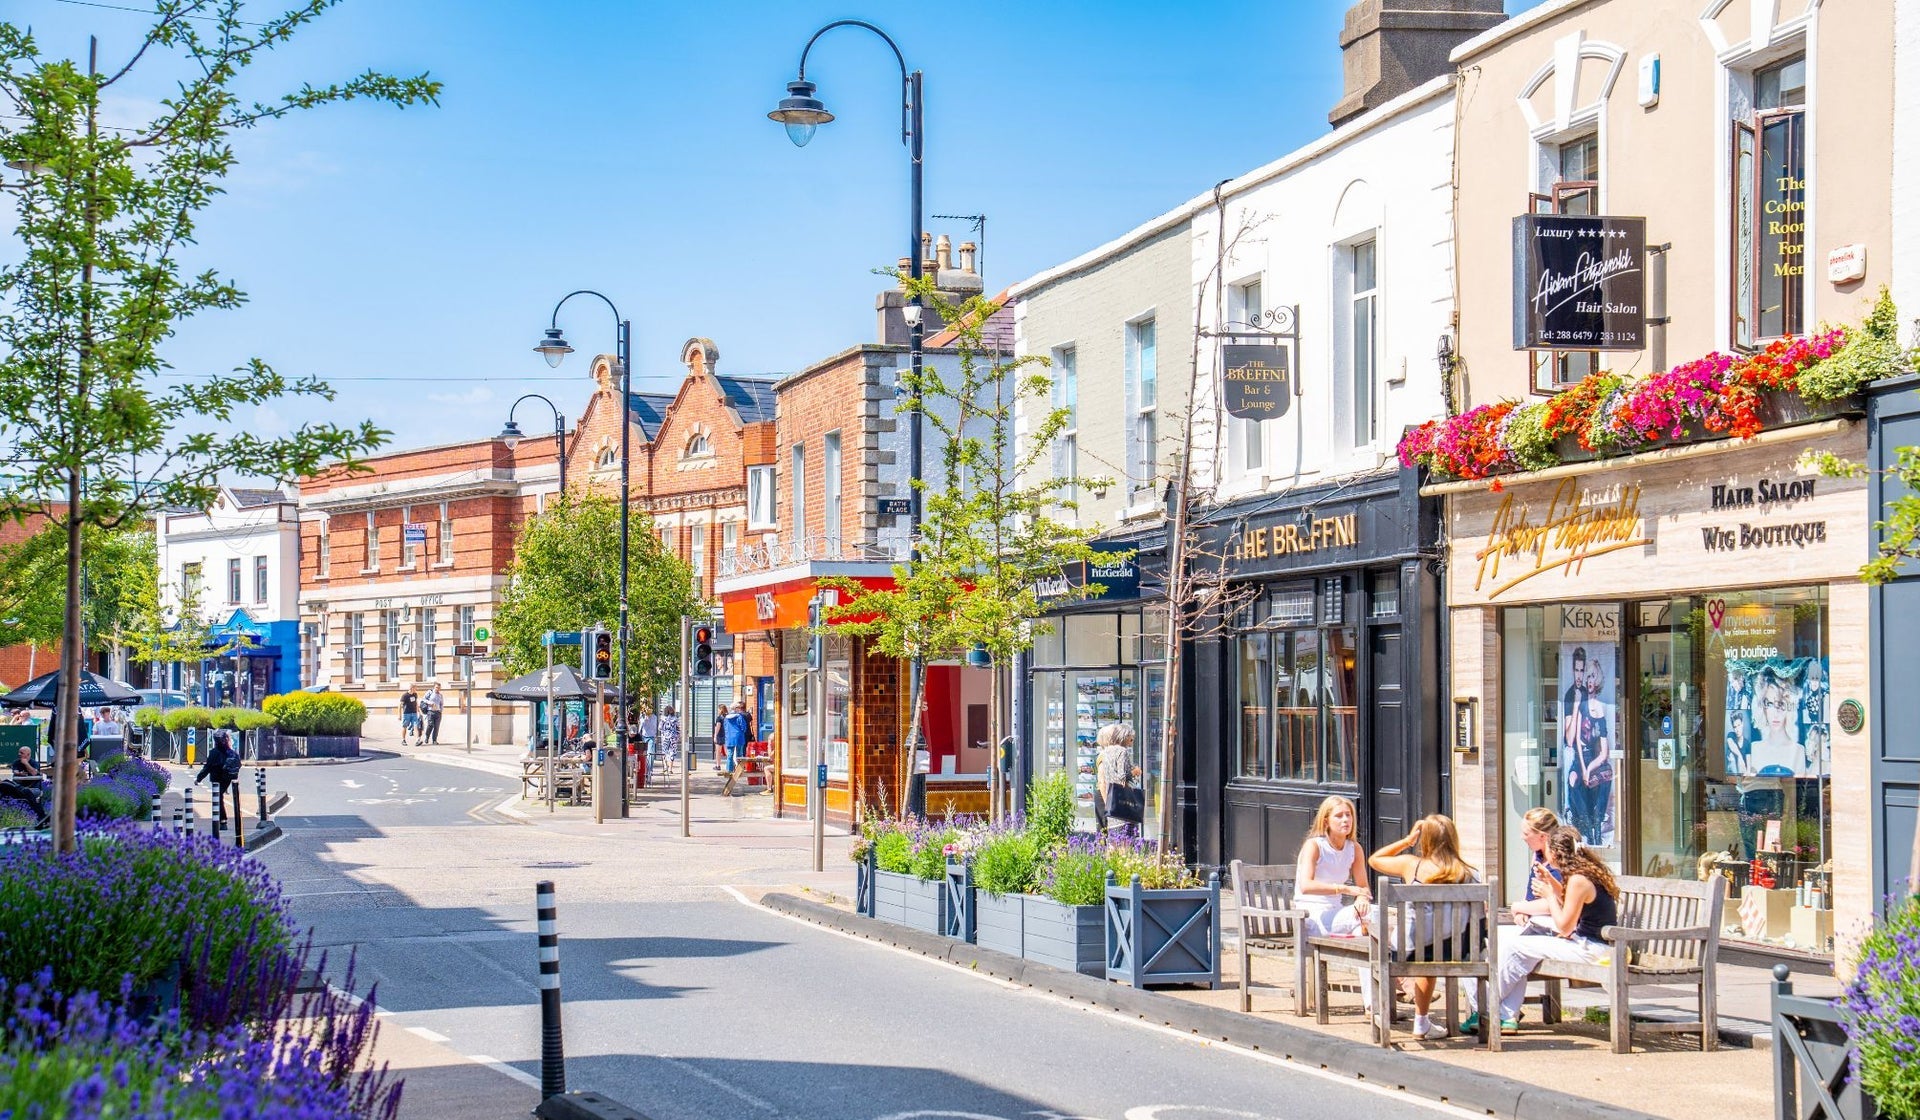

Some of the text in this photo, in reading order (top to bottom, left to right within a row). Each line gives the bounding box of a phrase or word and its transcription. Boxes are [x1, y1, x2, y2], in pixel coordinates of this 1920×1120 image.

[1535, 226, 1574, 240] Luxury
[1778, 241, 1804, 255] For
[1575, 301, 1638, 315] Hair Salon
[1539, 330, 1555, 340] Tel:
[1556, 330, 1571, 340] 288
[1572, 331, 1593, 341] 6479
[1617, 333, 1636, 342] 1124
[1247, 360, 1265, 368] THE
[1228, 368, 1286, 381] BREFFNI
[1244, 384, 1272, 395] Bar &
[1241, 398, 1276, 412] Lounge
[1091, 568, 1133, 577] FitzGerald
[375, 594, 444, 608] POST OFFICE
[1724, 645, 1778, 660] wig boutique
[519, 685, 561, 693] GUINNSS
